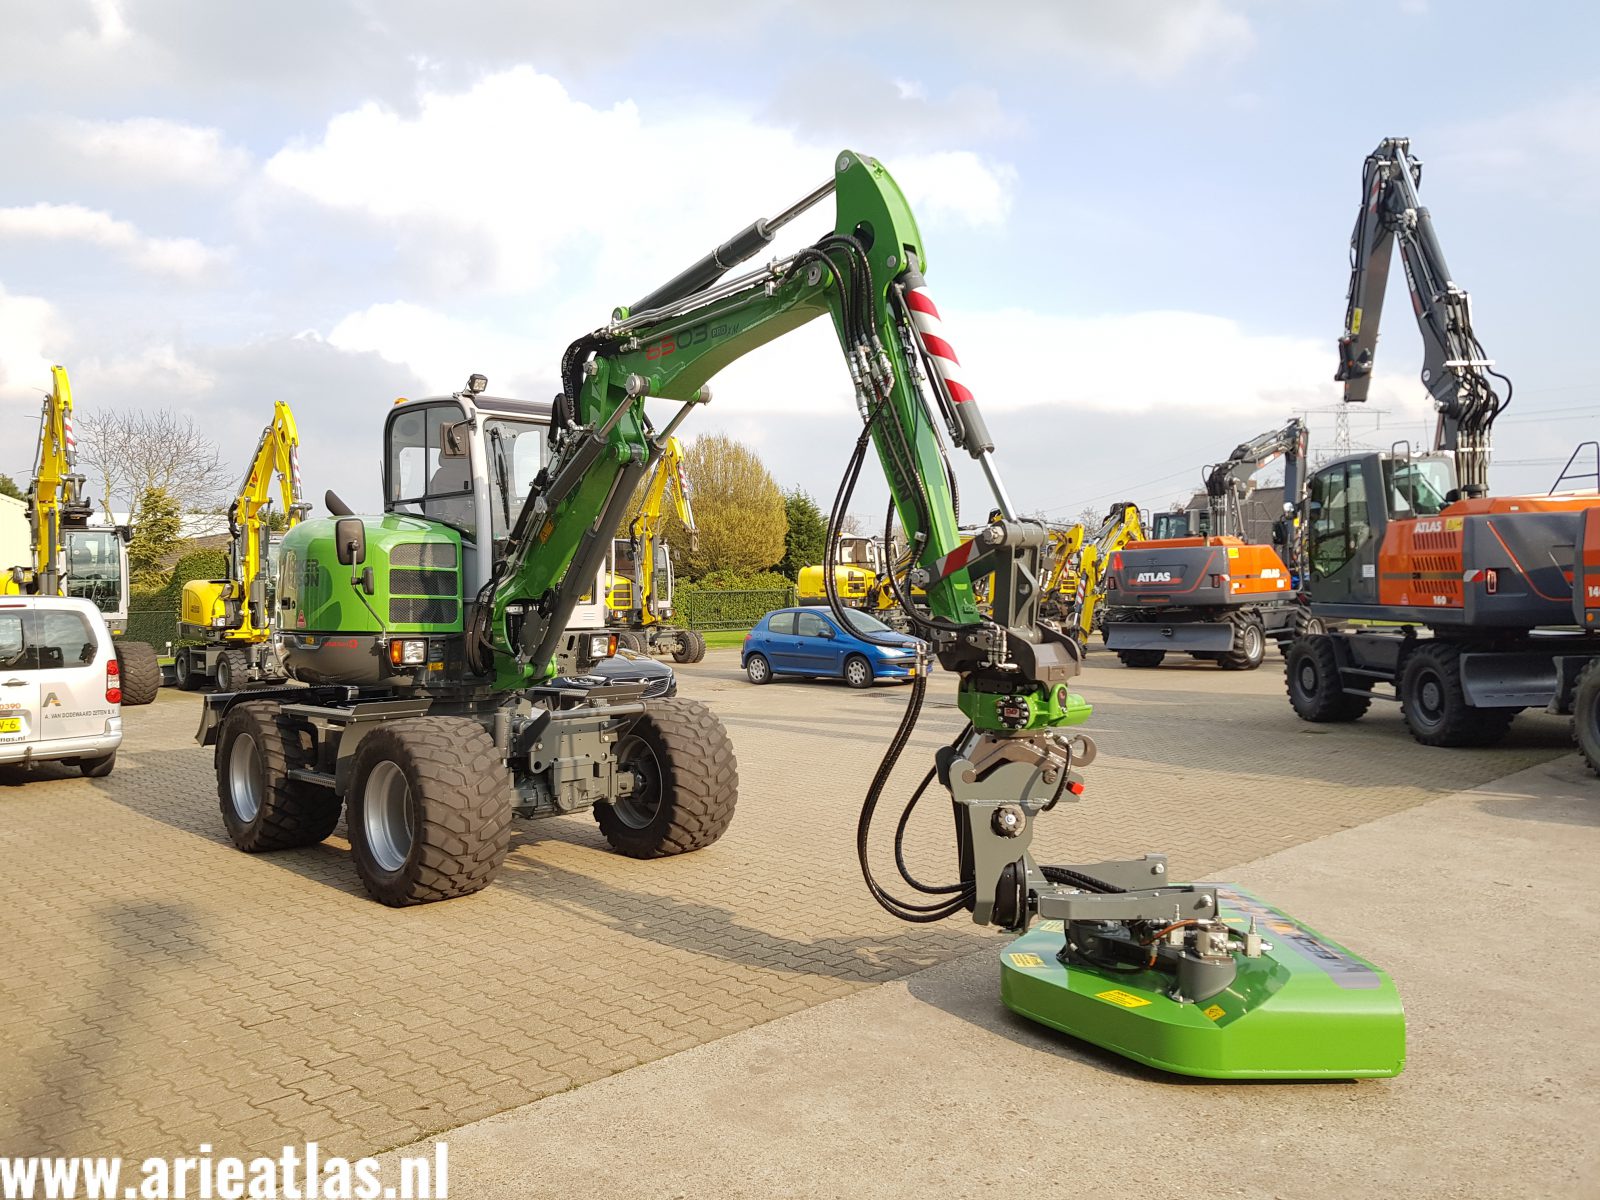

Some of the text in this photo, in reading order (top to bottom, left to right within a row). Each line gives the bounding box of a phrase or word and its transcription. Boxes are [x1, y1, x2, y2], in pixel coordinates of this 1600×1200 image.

[1414, 521, 1442, 533] ATLAS
[1136, 572, 1171, 583] ATLAS
[1260, 568, 1281, 579] ATLAS
